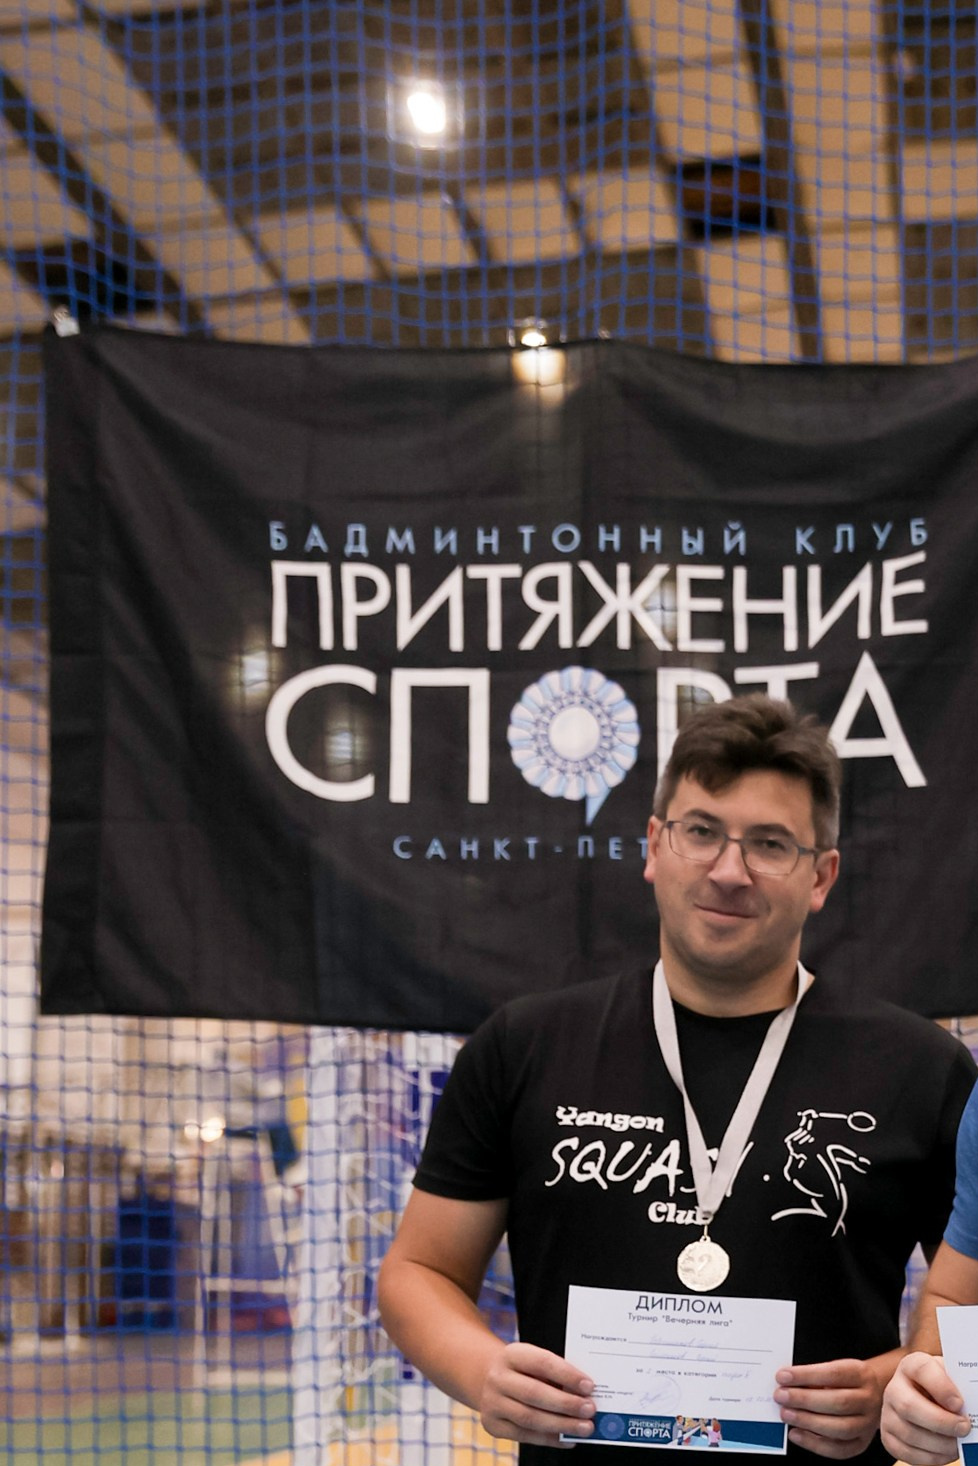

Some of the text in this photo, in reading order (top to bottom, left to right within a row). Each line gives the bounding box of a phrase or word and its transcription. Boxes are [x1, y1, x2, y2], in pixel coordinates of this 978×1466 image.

[269, 517, 929, 557] БАДМИНТОННЫЙ КЛУБ
[270, 551, 929, 653] ПРИТЯЖЕНИЕ
[393, 834, 648, 861] САНКТ-ПЕТ
[628, 1312, 659, 1323] Турнир
[635, 1295, 724, 1315] ДИПЛОМ
